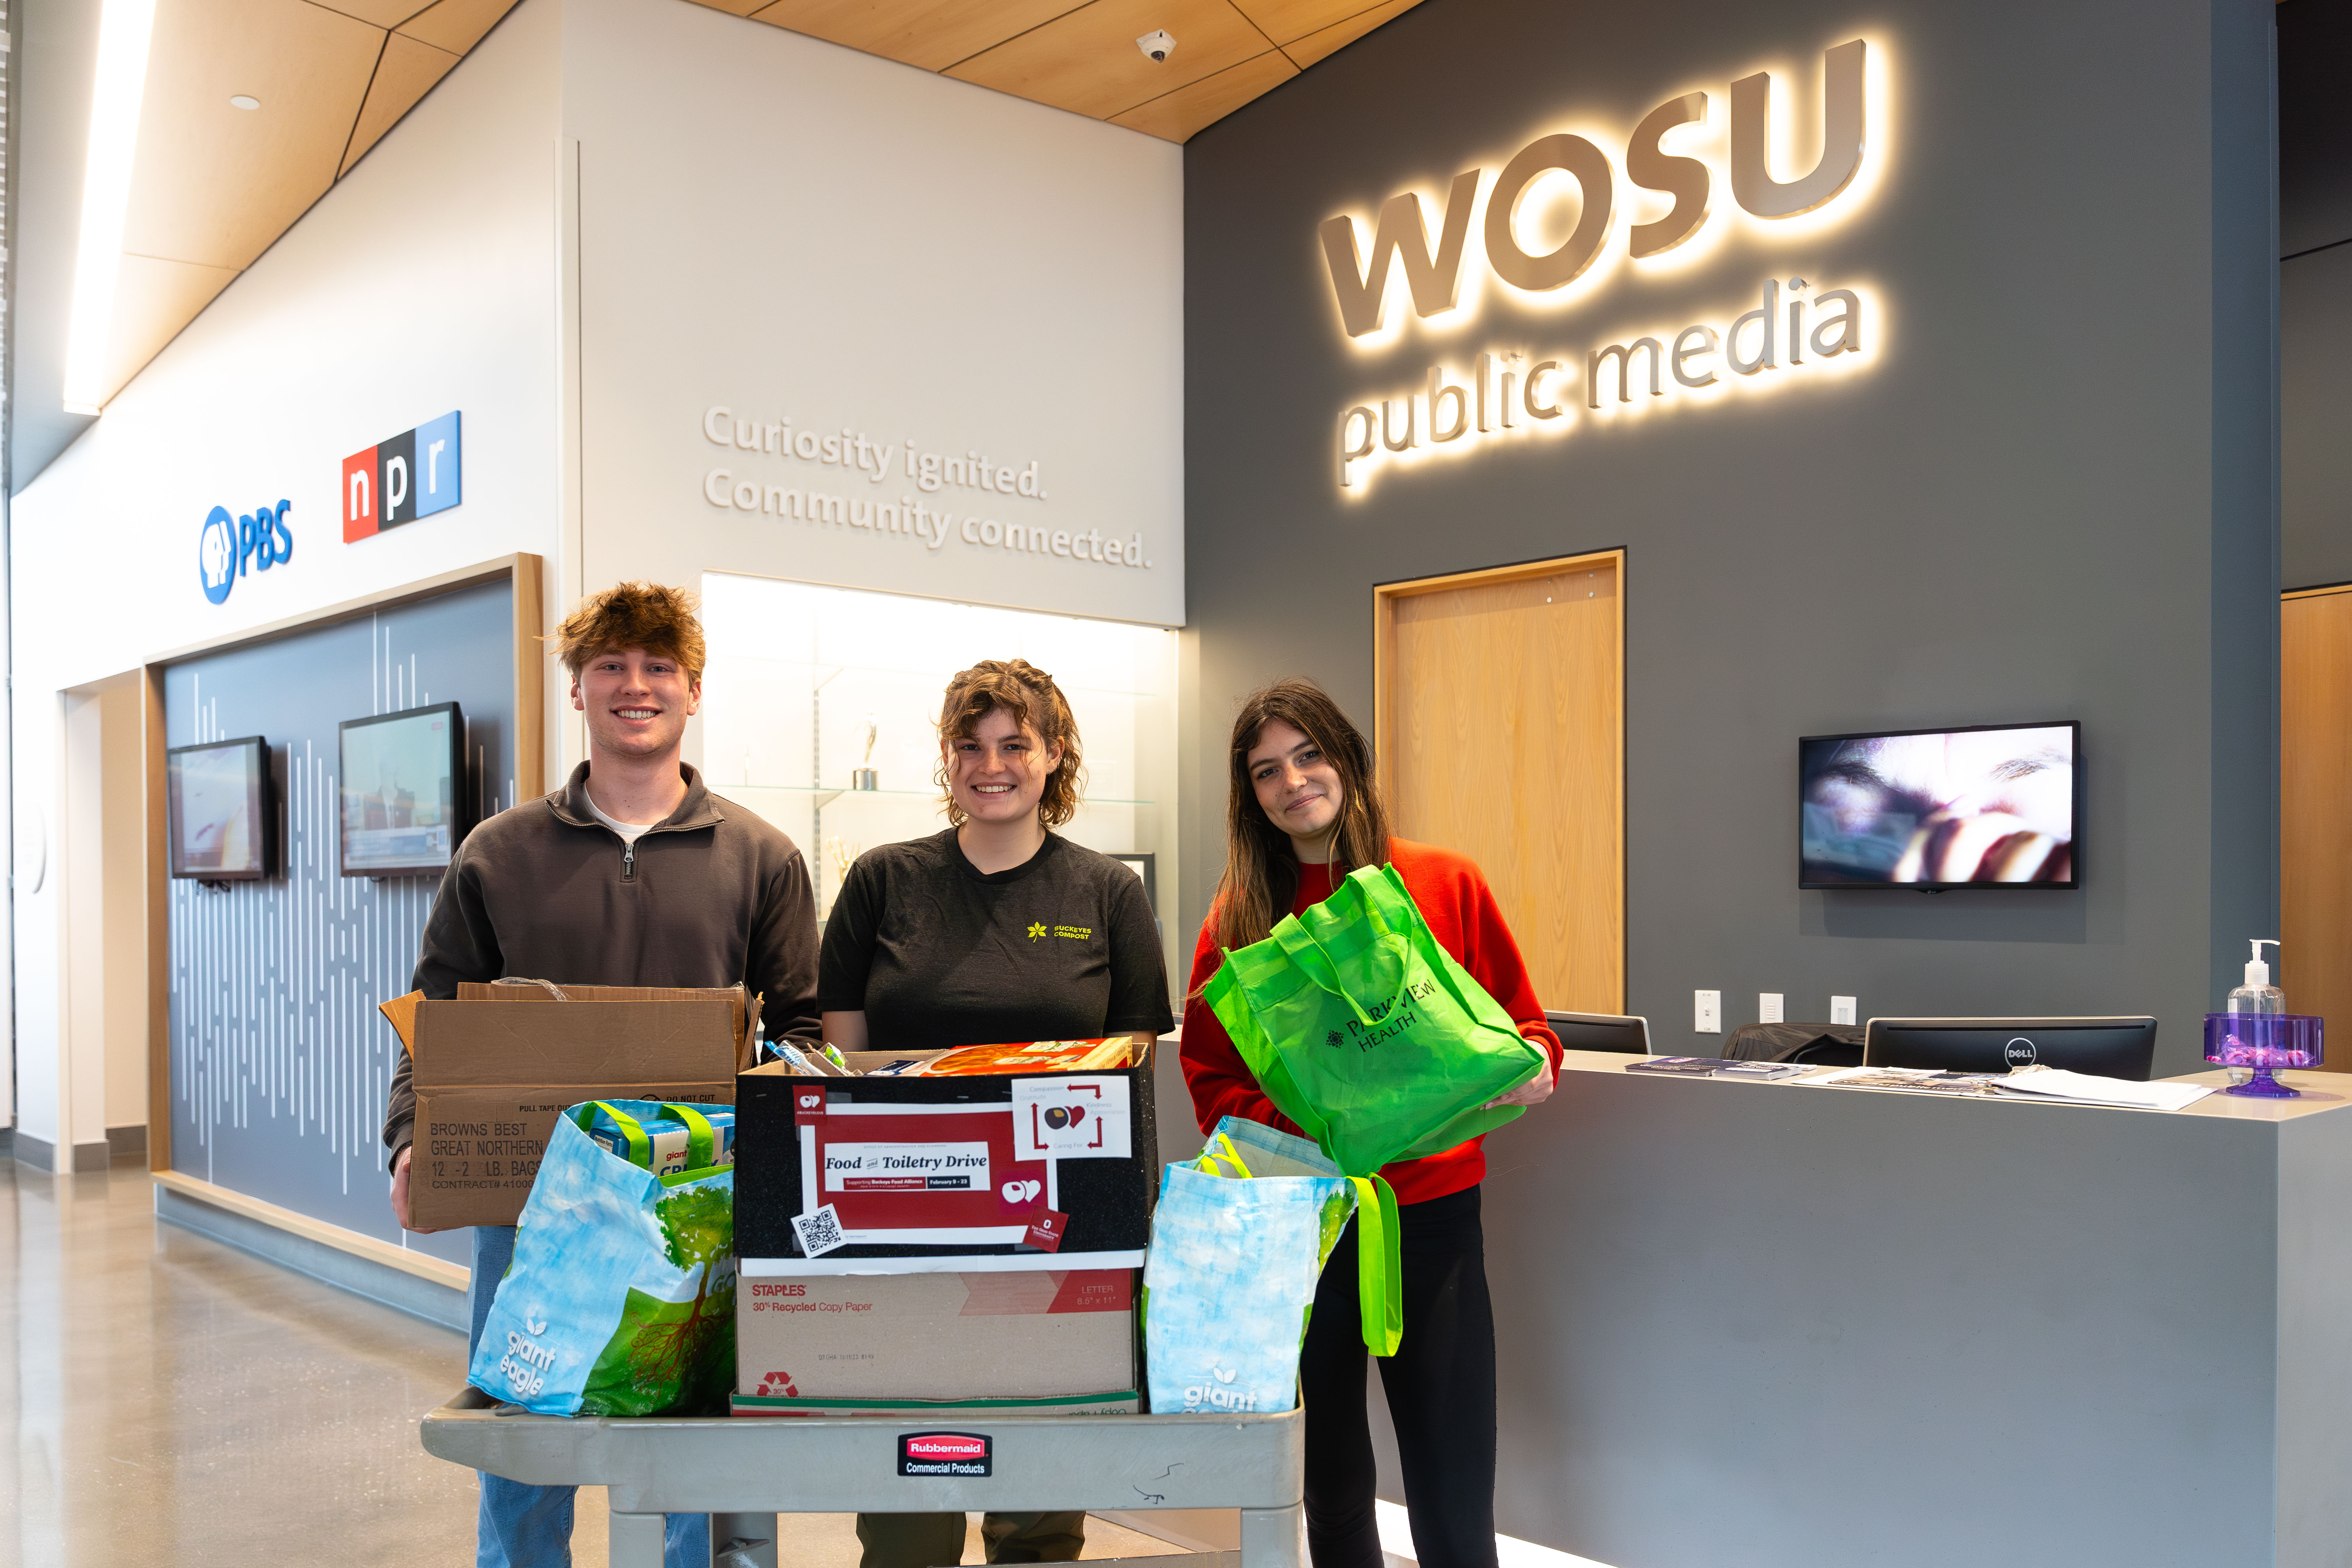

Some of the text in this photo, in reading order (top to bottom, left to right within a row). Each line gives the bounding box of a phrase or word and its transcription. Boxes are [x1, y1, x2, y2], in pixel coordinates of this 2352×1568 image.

[1319, 38, 1866, 338] WOSU
[1337, 277, 1861, 487] public media
[703, 406, 1048, 499] Curiosity ignited.
[350, 438, 445, 521] npr
[703, 469, 1153, 568] Community connected.
[239, 499, 293, 577] PBS
[1054, 925, 1091, 934] BUCKEYES
[1357, 1011, 1417, 1052] HEALTH
[2008, 1049, 2033, 1058] DELL
[430, 1123, 527, 1136] BROWNS BEST
[431, 1140, 543, 1156] GREAT NORTHERN
[666, 1150, 688, 1161] giant
[432, 1161, 444, 1177] 12
[486, 1161, 504, 1177] LB.
[825, 1156, 862, 1169] Food
[883, 1155, 942, 1171] Toiletry
[946, 1154, 987, 1167] Drive
[432, 1180, 500, 1189] CONTRACT#
[753, 1284, 806, 1296] STAPLES
[753, 1302, 872, 1313] 30% Recycled Copy Paper
[508, 1331, 556, 1373] giant
[500, 1354, 544, 1395] eagle
[1184, 1381, 1257, 1411] giant
[911, 1443, 980, 1453] Rubbermaid
[906, 1462, 985, 1474] Commercial Products
